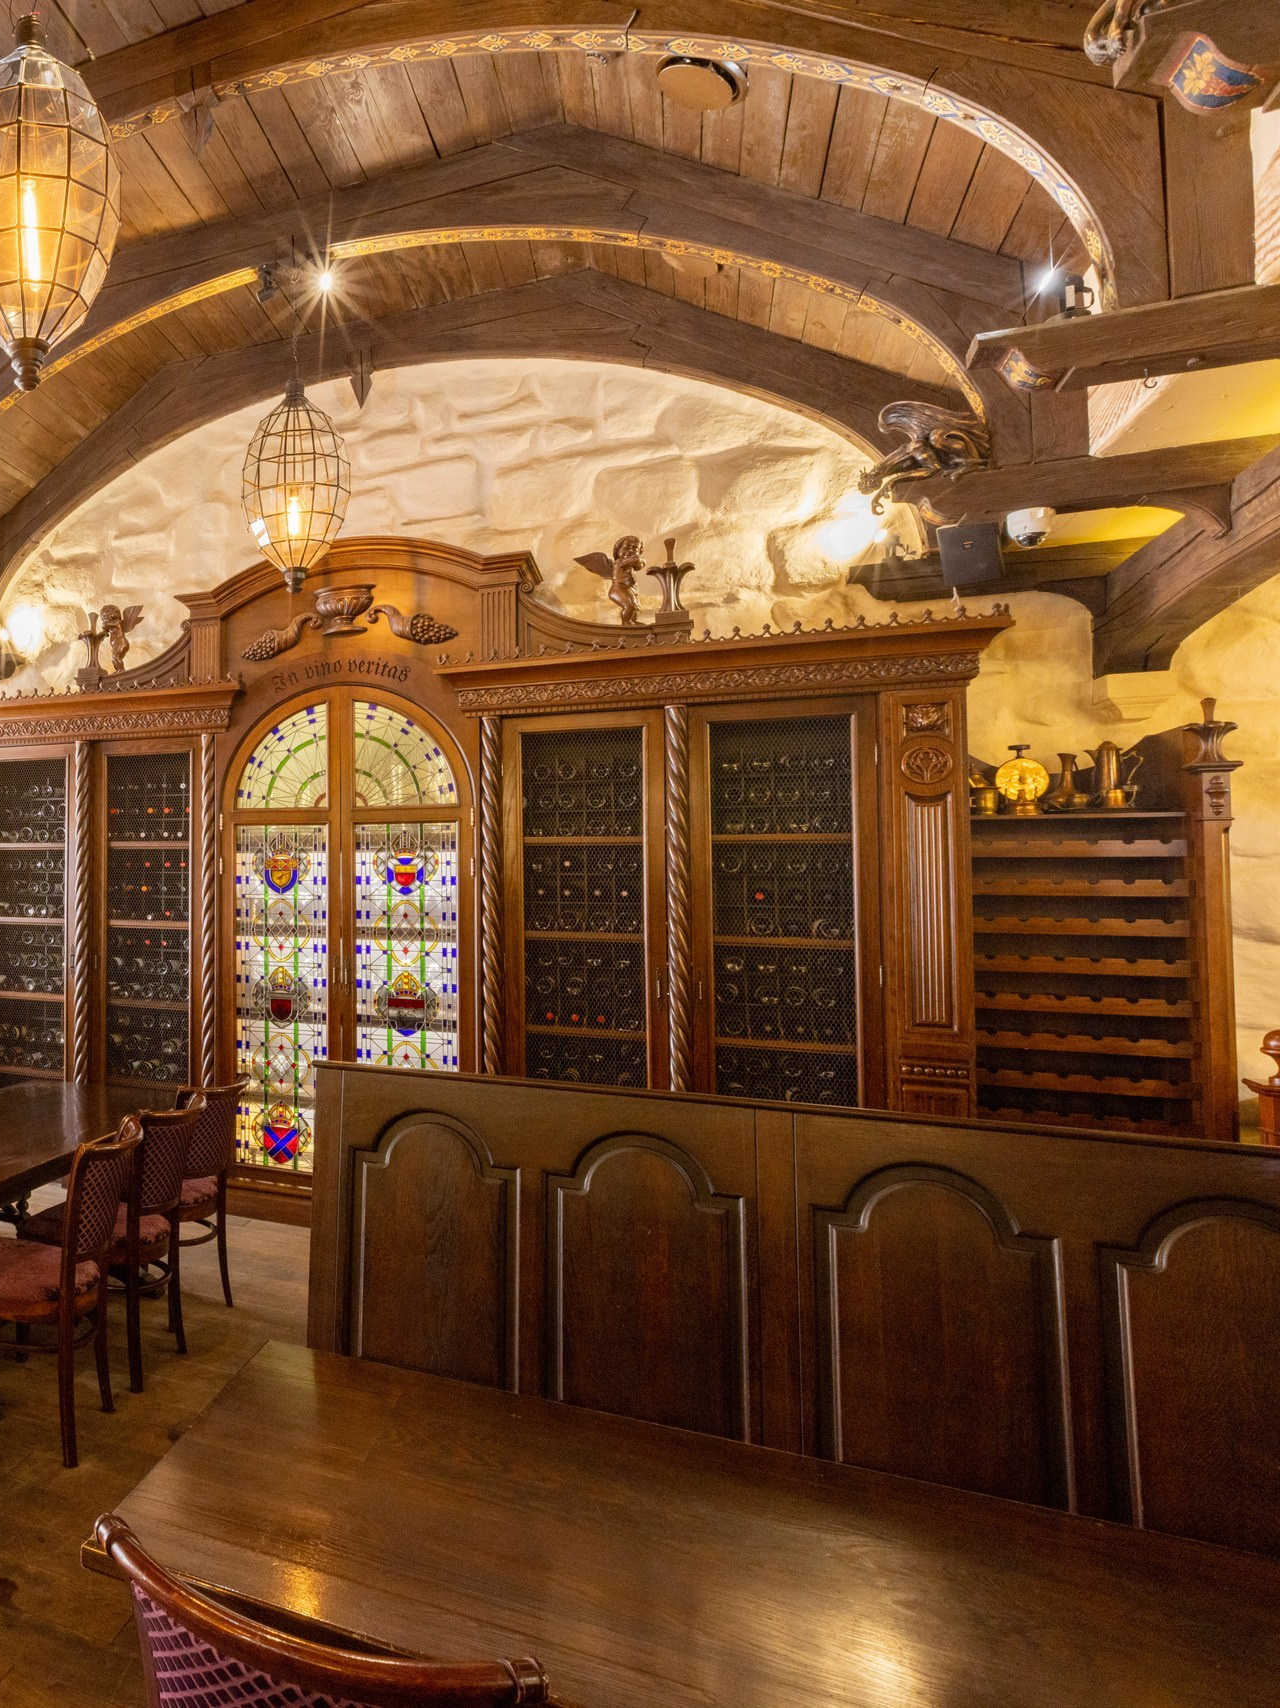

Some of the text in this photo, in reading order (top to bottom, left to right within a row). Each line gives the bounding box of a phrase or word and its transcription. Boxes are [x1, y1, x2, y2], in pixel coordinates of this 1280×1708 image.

[271, 657, 412, 693] In vino veritas
